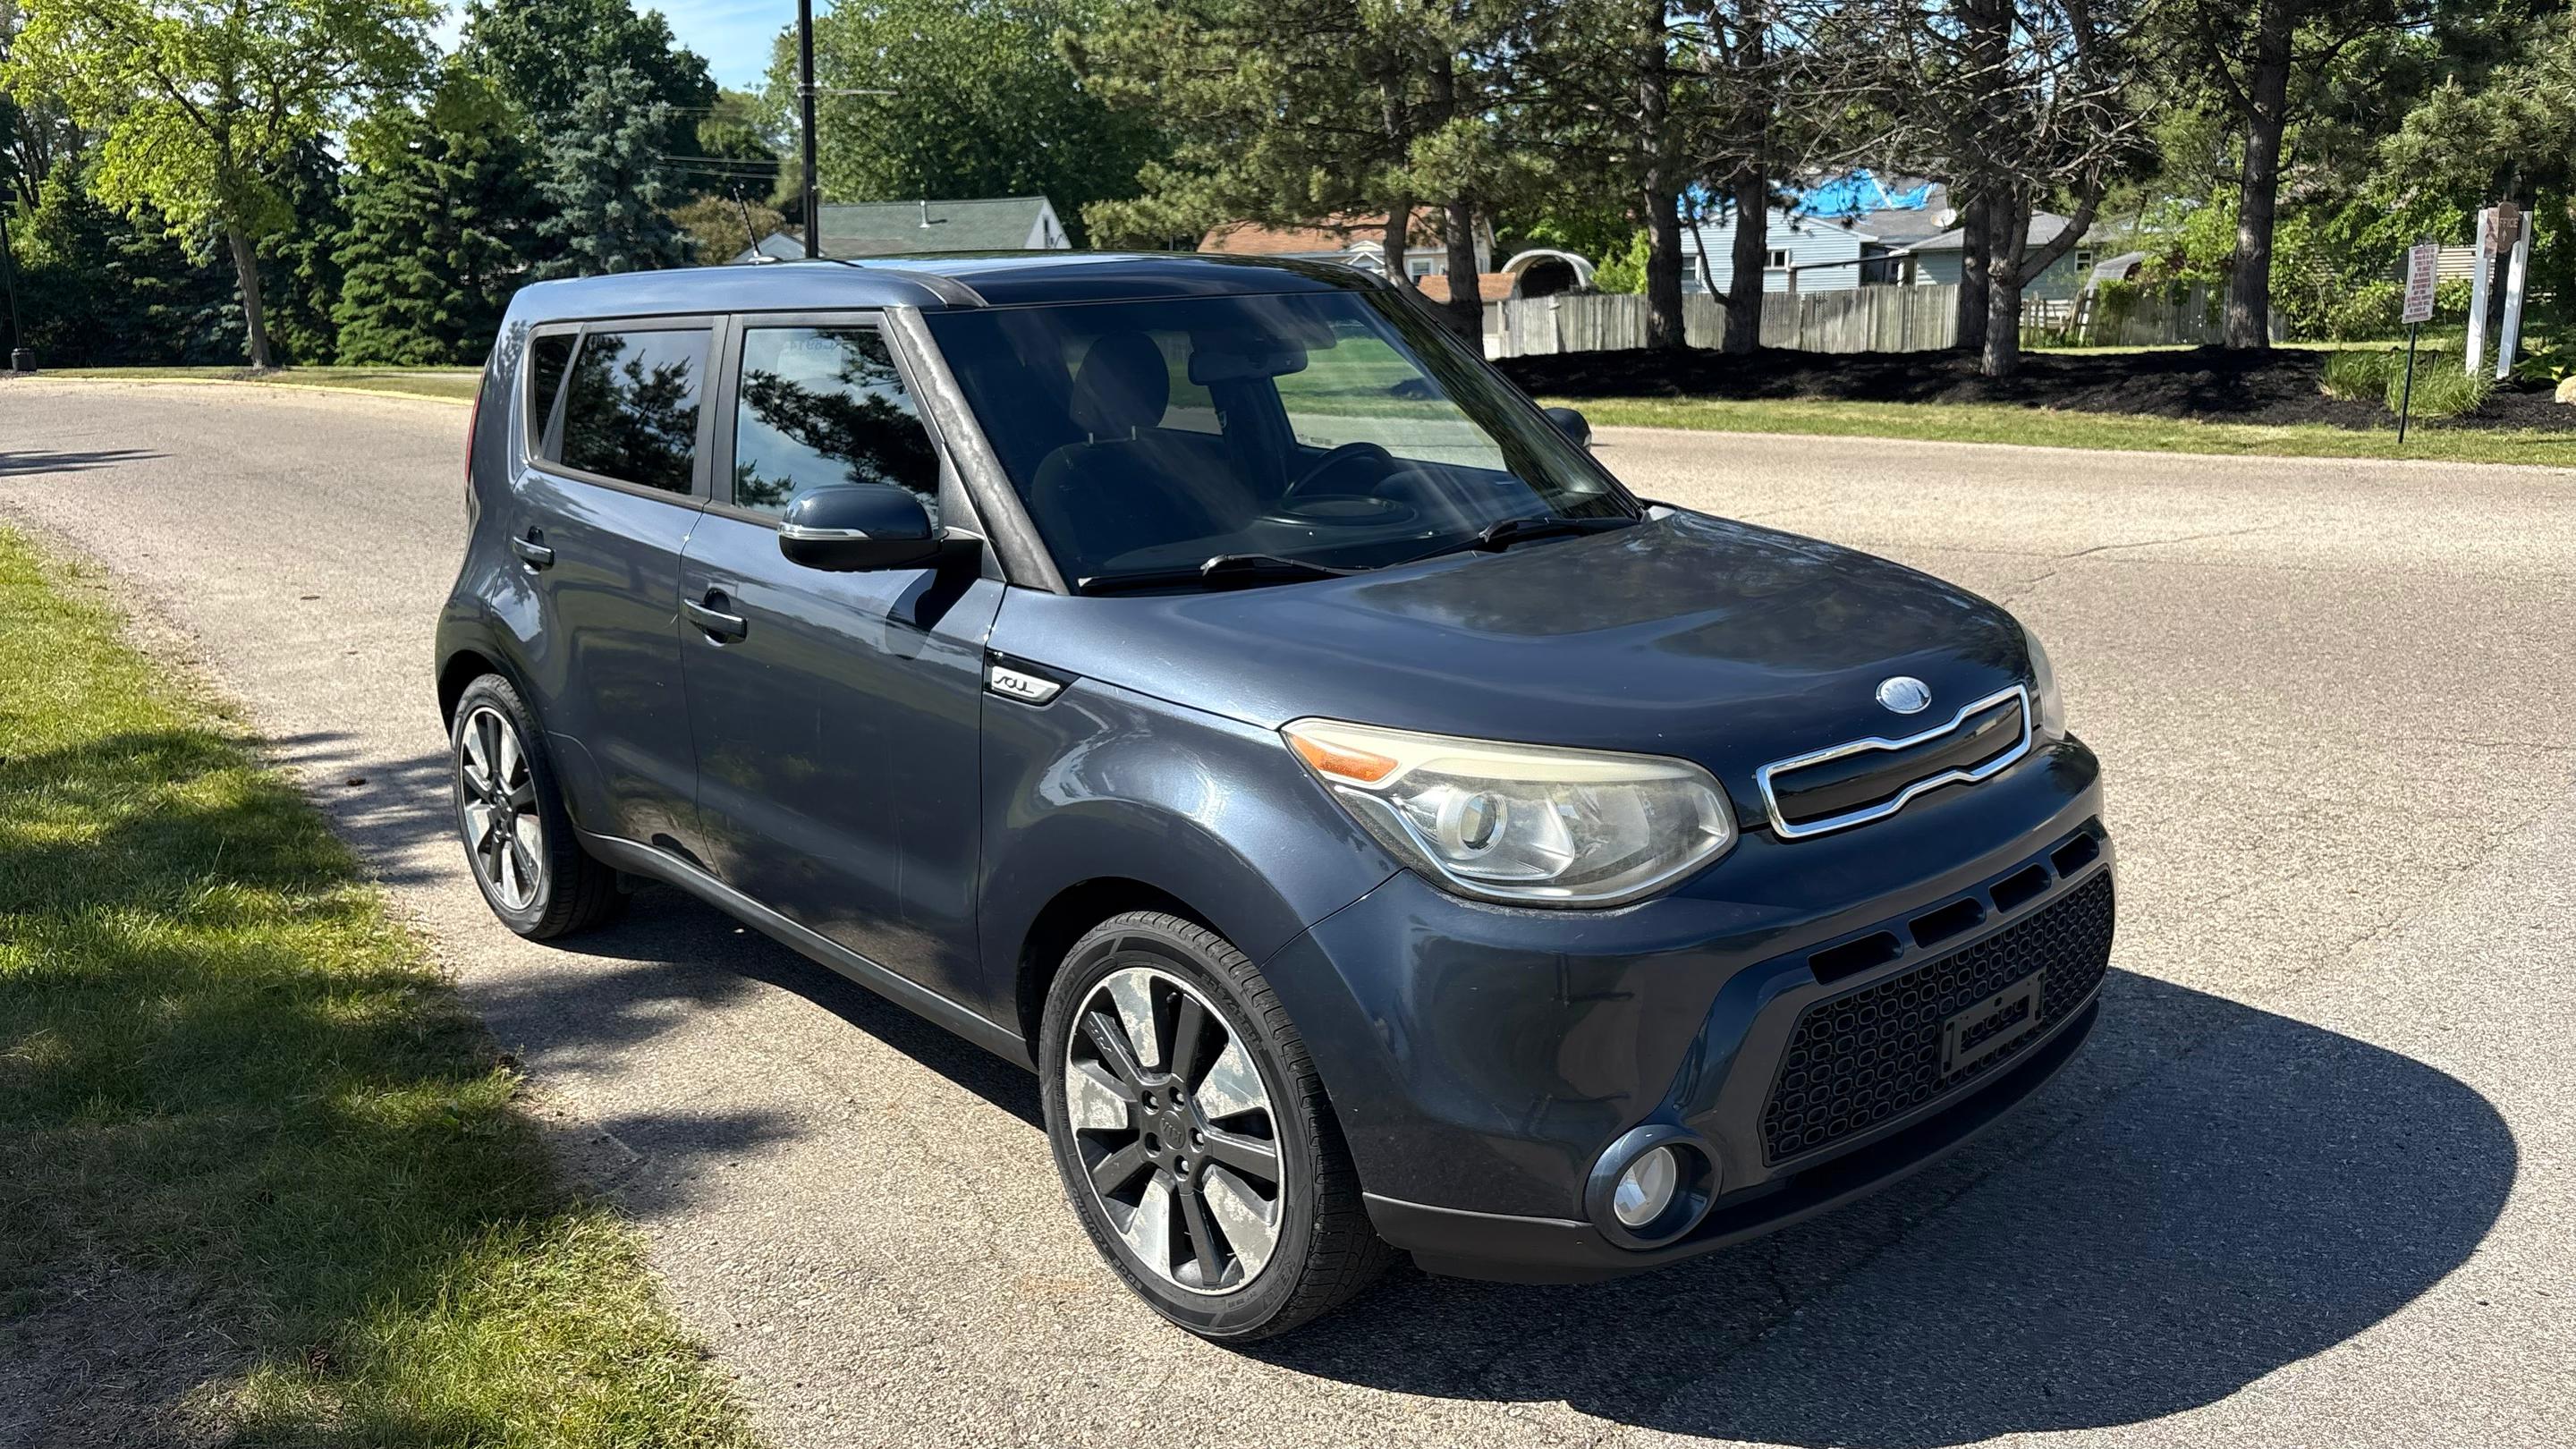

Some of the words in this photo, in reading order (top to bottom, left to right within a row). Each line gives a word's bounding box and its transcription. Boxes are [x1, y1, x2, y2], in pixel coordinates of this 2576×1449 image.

[2499, 217, 2519, 229] FFICE
[1072, 1187, 1109, 1252] TOURING
[1113, 1256, 1143, 1291] EDGE
